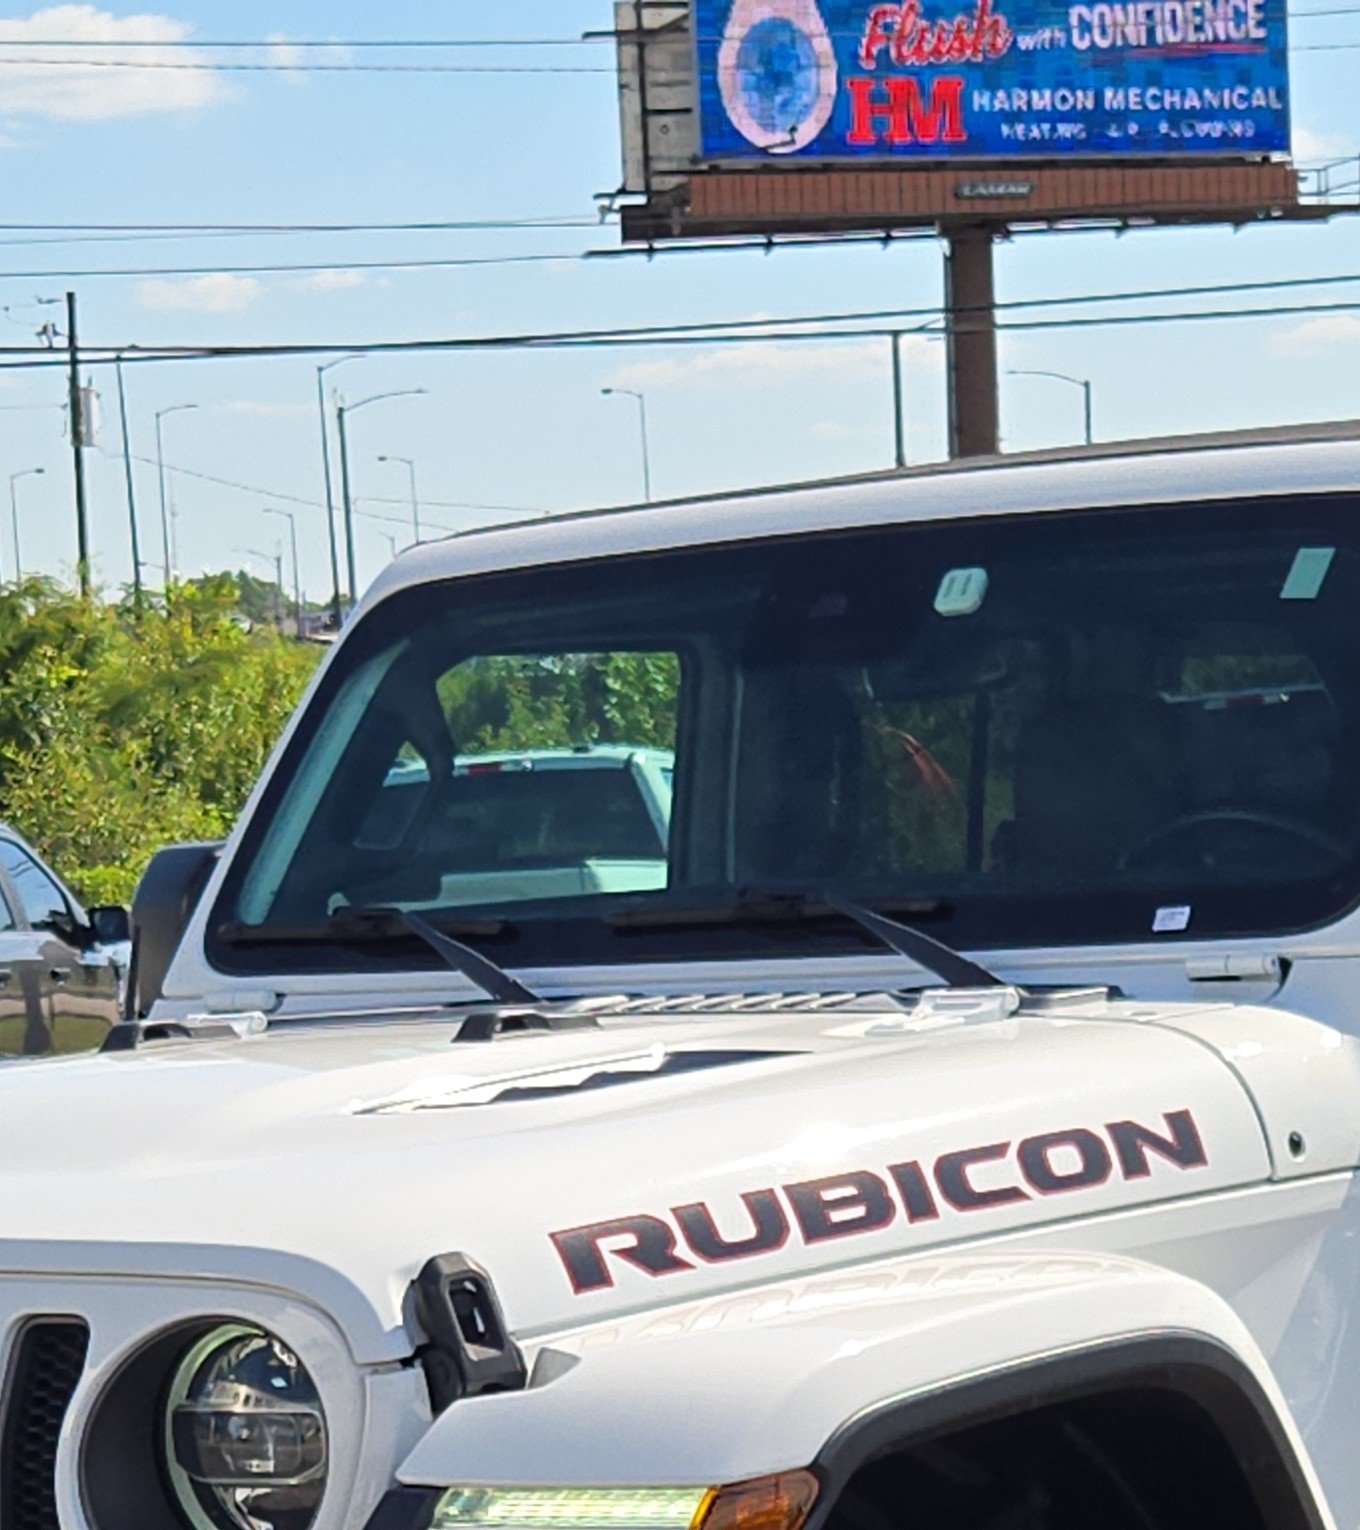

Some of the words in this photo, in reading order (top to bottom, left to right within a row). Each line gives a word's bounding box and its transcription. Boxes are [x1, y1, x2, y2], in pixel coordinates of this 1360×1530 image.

[859, 0, 1013, 70] Flush
[1017, 28, 1067, 50] with
[1069, 0, 1268, 50] CONFIDENCE
[845, 75, 967, 145] HM
[972, 87, 1096, 112] HARMON
[1103, 86, 1283, 111] MECHANICAL
[548, 1109, 1210, 1295] RUBICON
